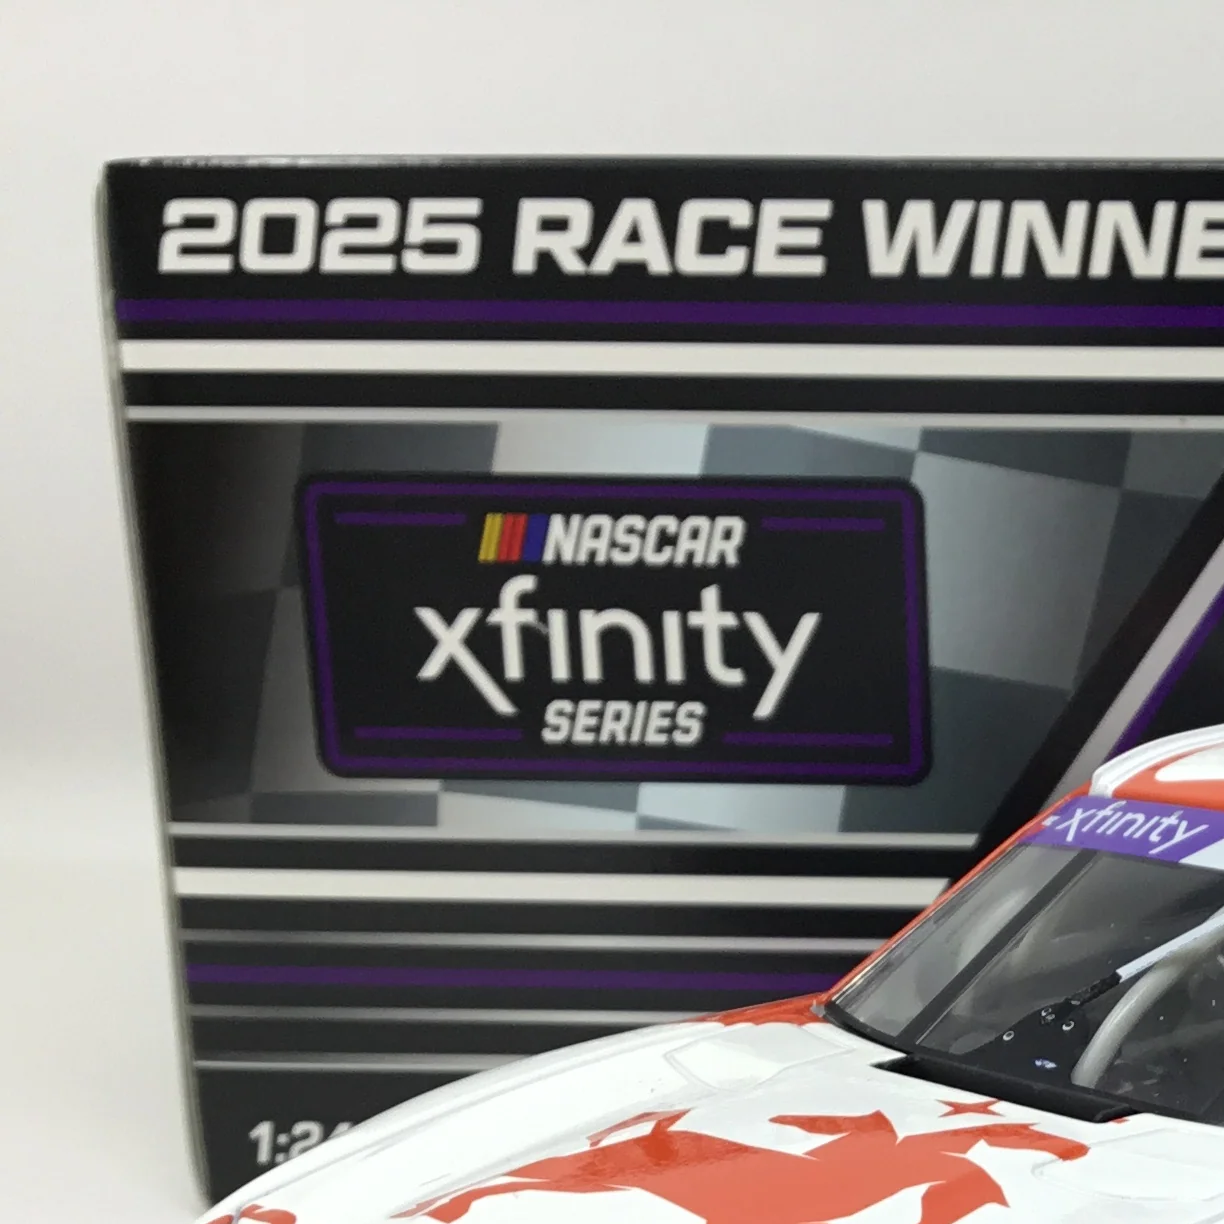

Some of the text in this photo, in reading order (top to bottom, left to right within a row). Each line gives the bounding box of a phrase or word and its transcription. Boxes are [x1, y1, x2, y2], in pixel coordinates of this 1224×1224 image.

[157, 197, 482, 274] 2025
[512, 198, 833, 276] RACE
[542, 513, 747, 567] NASCAR
[412, 573, 823, 721] xfinity
[540, 699, 707, 746] SERIES
[1054, 800, 1209, 855] xfinity
[247, 1119, 355, 1167] 1:2
